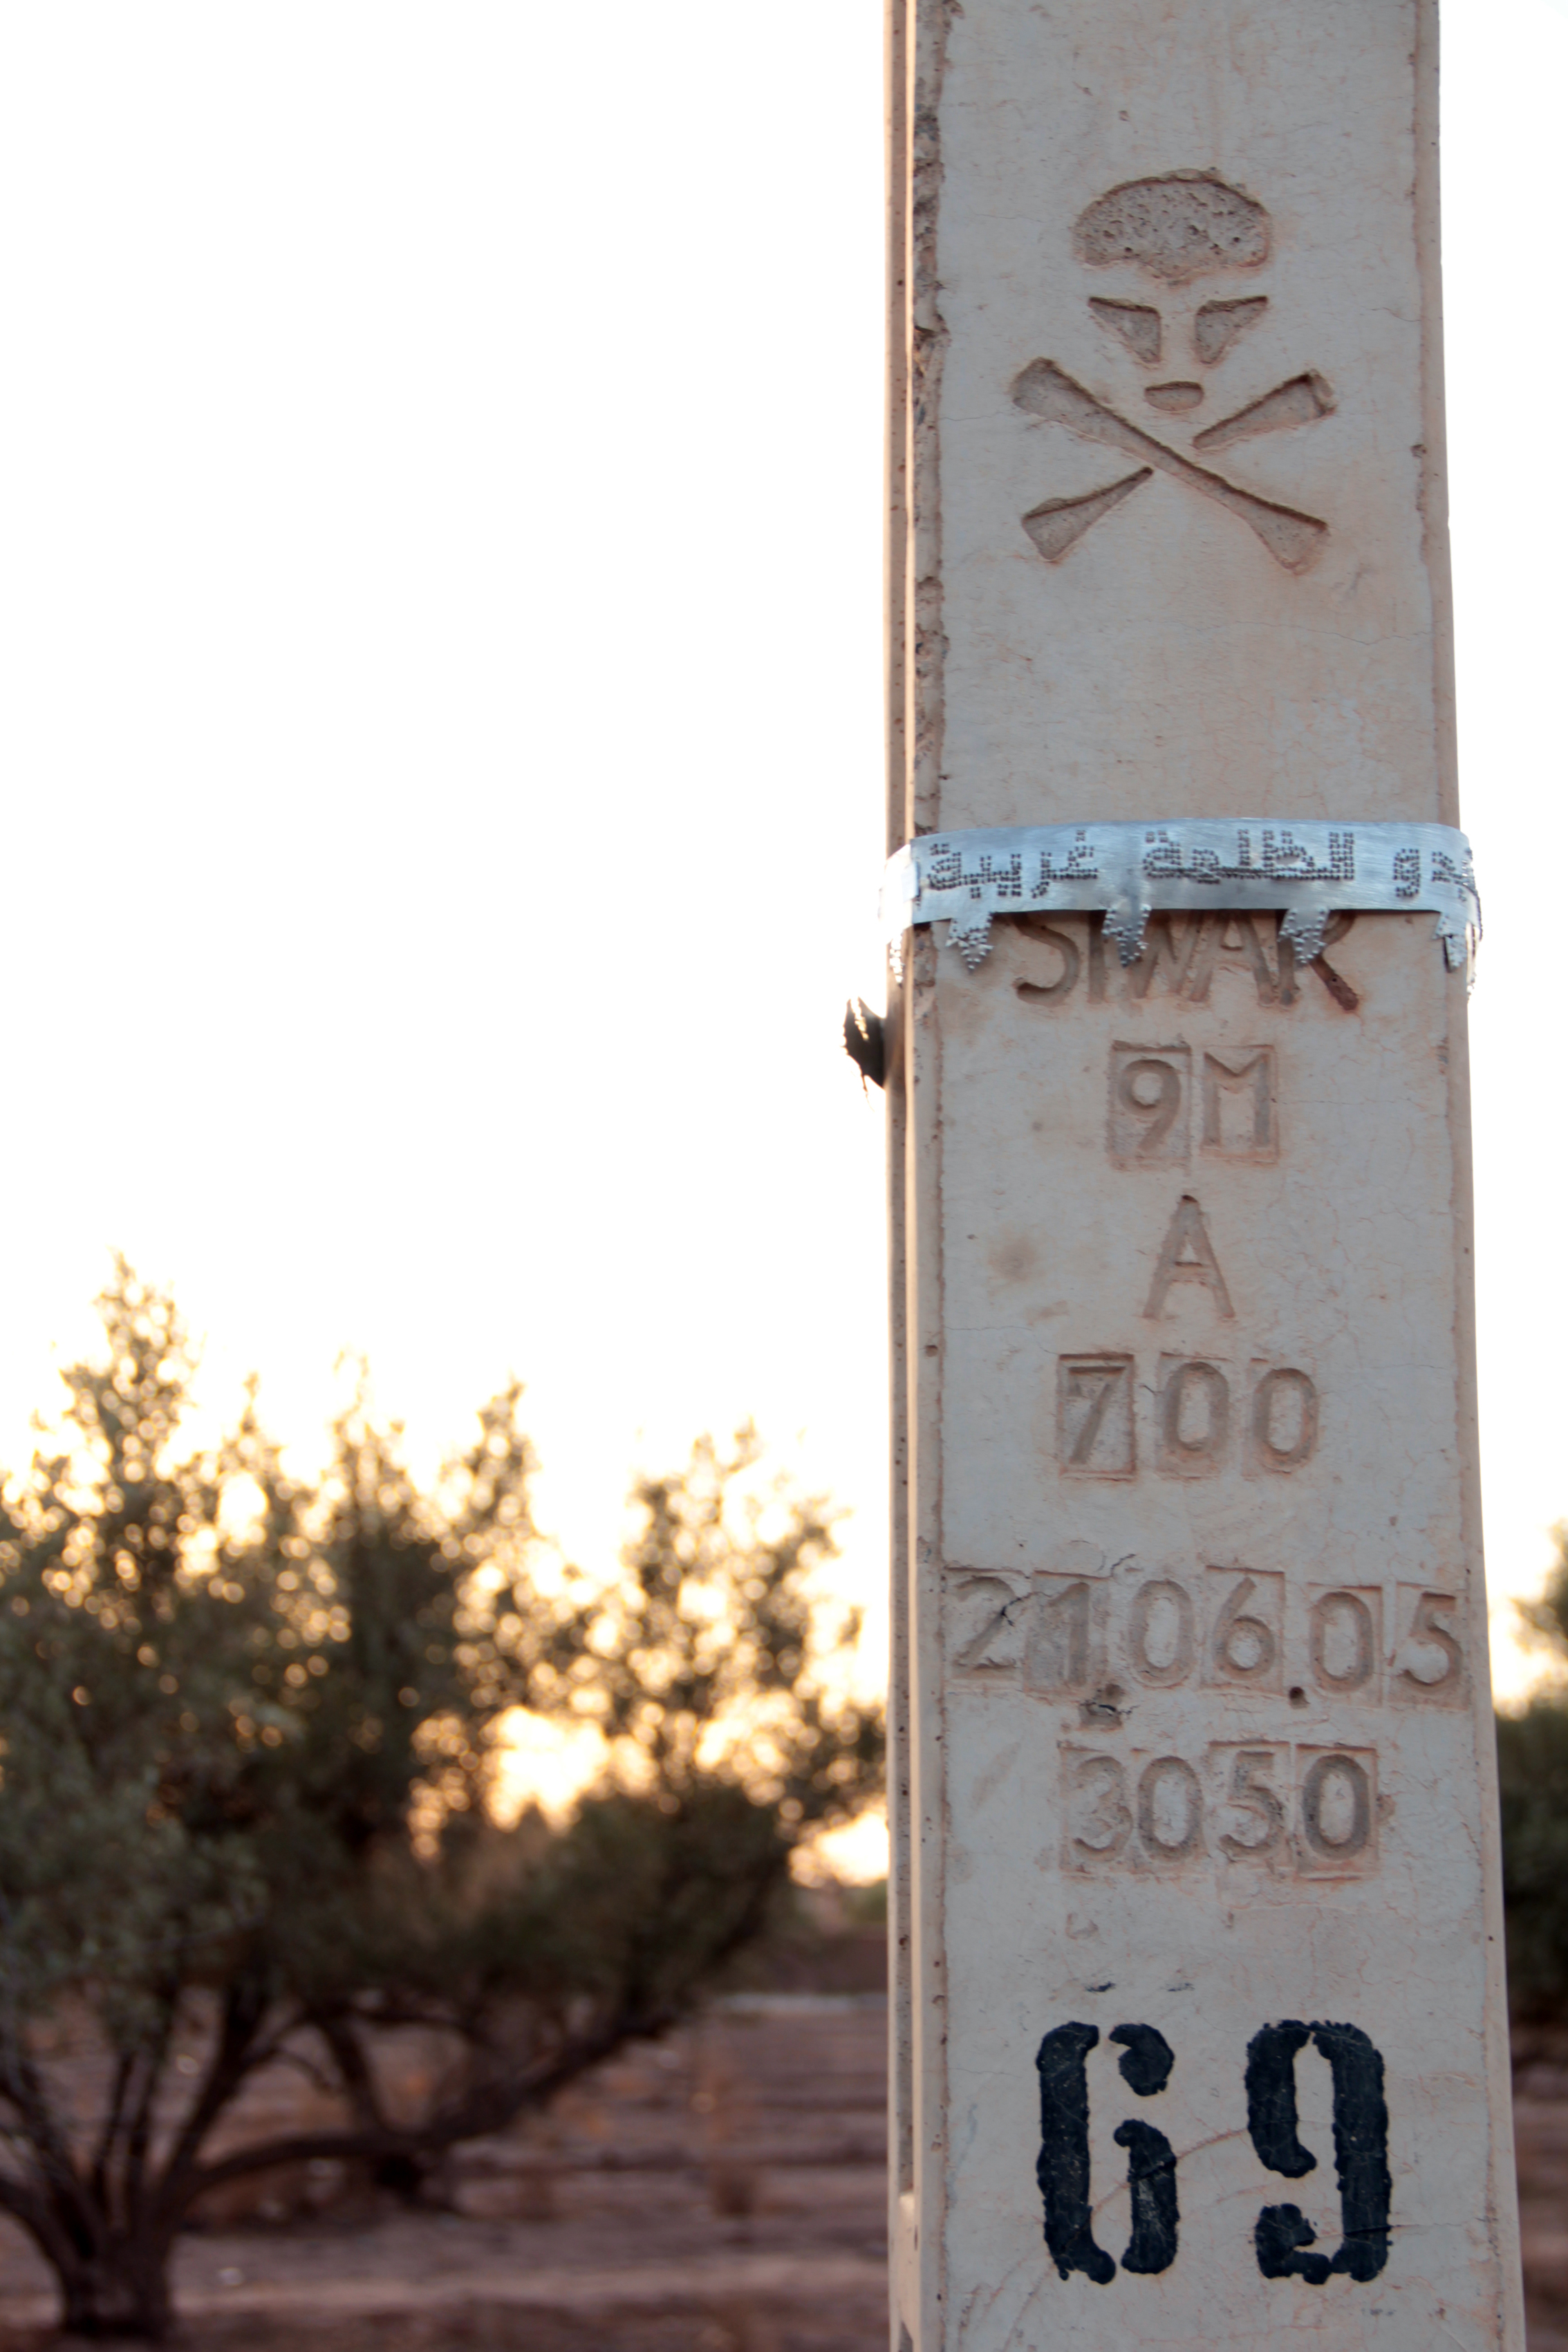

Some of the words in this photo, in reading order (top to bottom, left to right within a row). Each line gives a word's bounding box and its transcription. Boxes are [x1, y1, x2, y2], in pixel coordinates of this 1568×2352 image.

[926, 830, 1099, 899] غريبة
[1115, 1051, 1278, 1155] 9M
[1141, 1194, 1236, 1319] A
[1066, 1359, 1319, 1475] 700
[1071, 1753, 1373, 1864] 3050
[1036, 2019, 1392, 2285] 69
